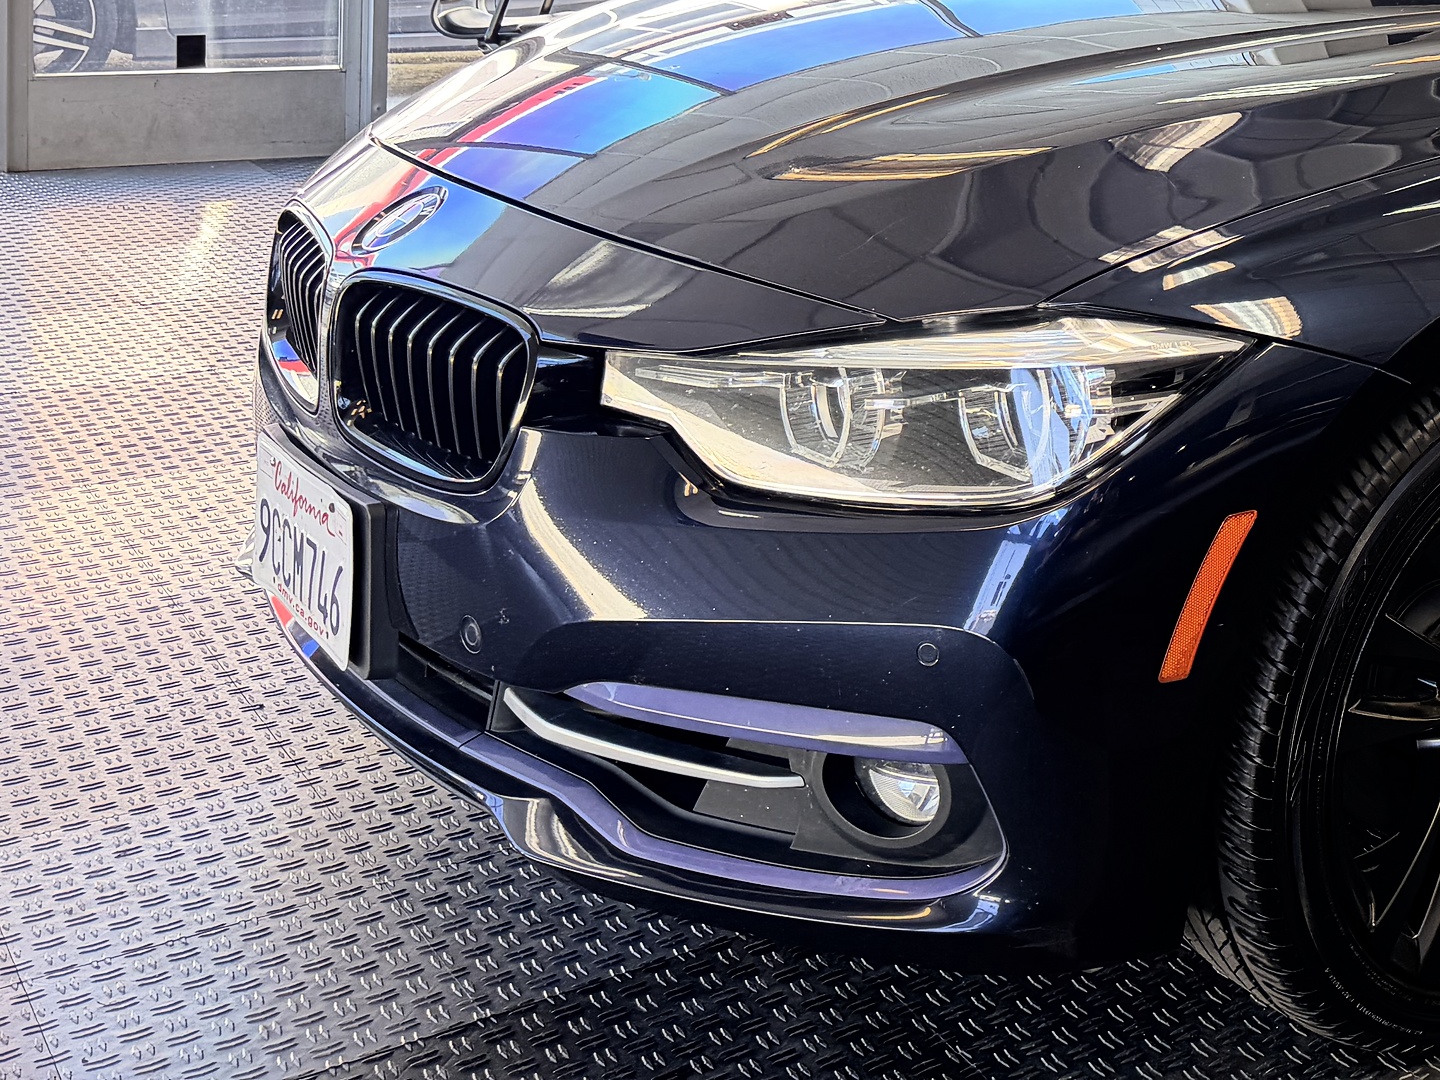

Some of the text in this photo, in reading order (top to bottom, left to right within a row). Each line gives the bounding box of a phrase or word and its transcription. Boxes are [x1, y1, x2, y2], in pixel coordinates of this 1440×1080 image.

[272, 460, 336, 538] California
[258, 497, 344, 637] 9CCM746
[277, 582, 325, 636] dmv.ca.gov
